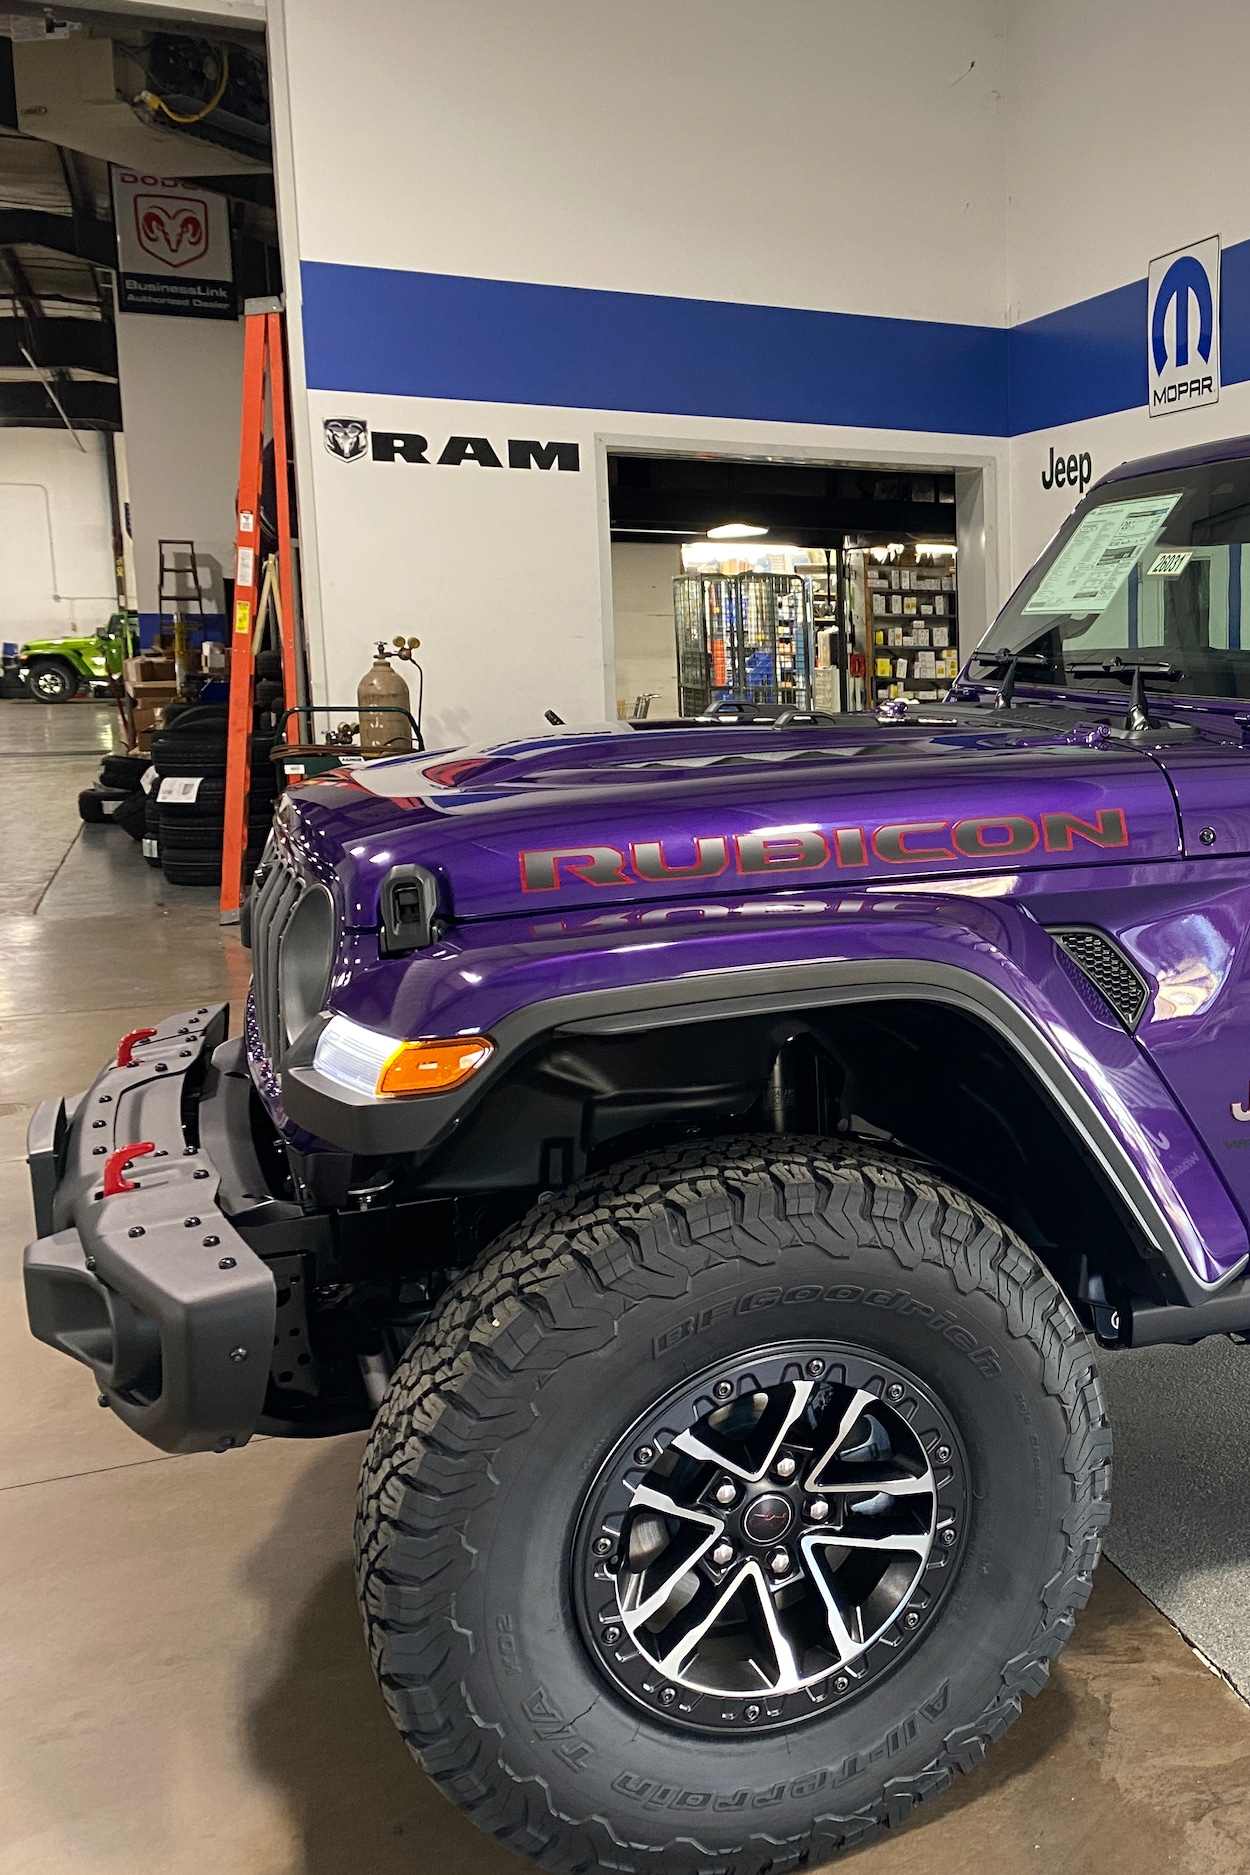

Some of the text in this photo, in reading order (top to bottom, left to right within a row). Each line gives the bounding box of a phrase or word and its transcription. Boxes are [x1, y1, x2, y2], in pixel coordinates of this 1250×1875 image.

[124, 279, 229, 299] BusinessLink
[126, 293, 231, 311] Authorized Dealer
[1153, 375, 1213, 407] MOPAR
[370, 431, 581, 472] RAM
[1041, 446, 1092, 494] Jeep
[1152, 554, 1187, 572] 26031
[518, 808, 1130, 894] RUBICON
[652, 1284, 1002, 1380] BFGoodrich
